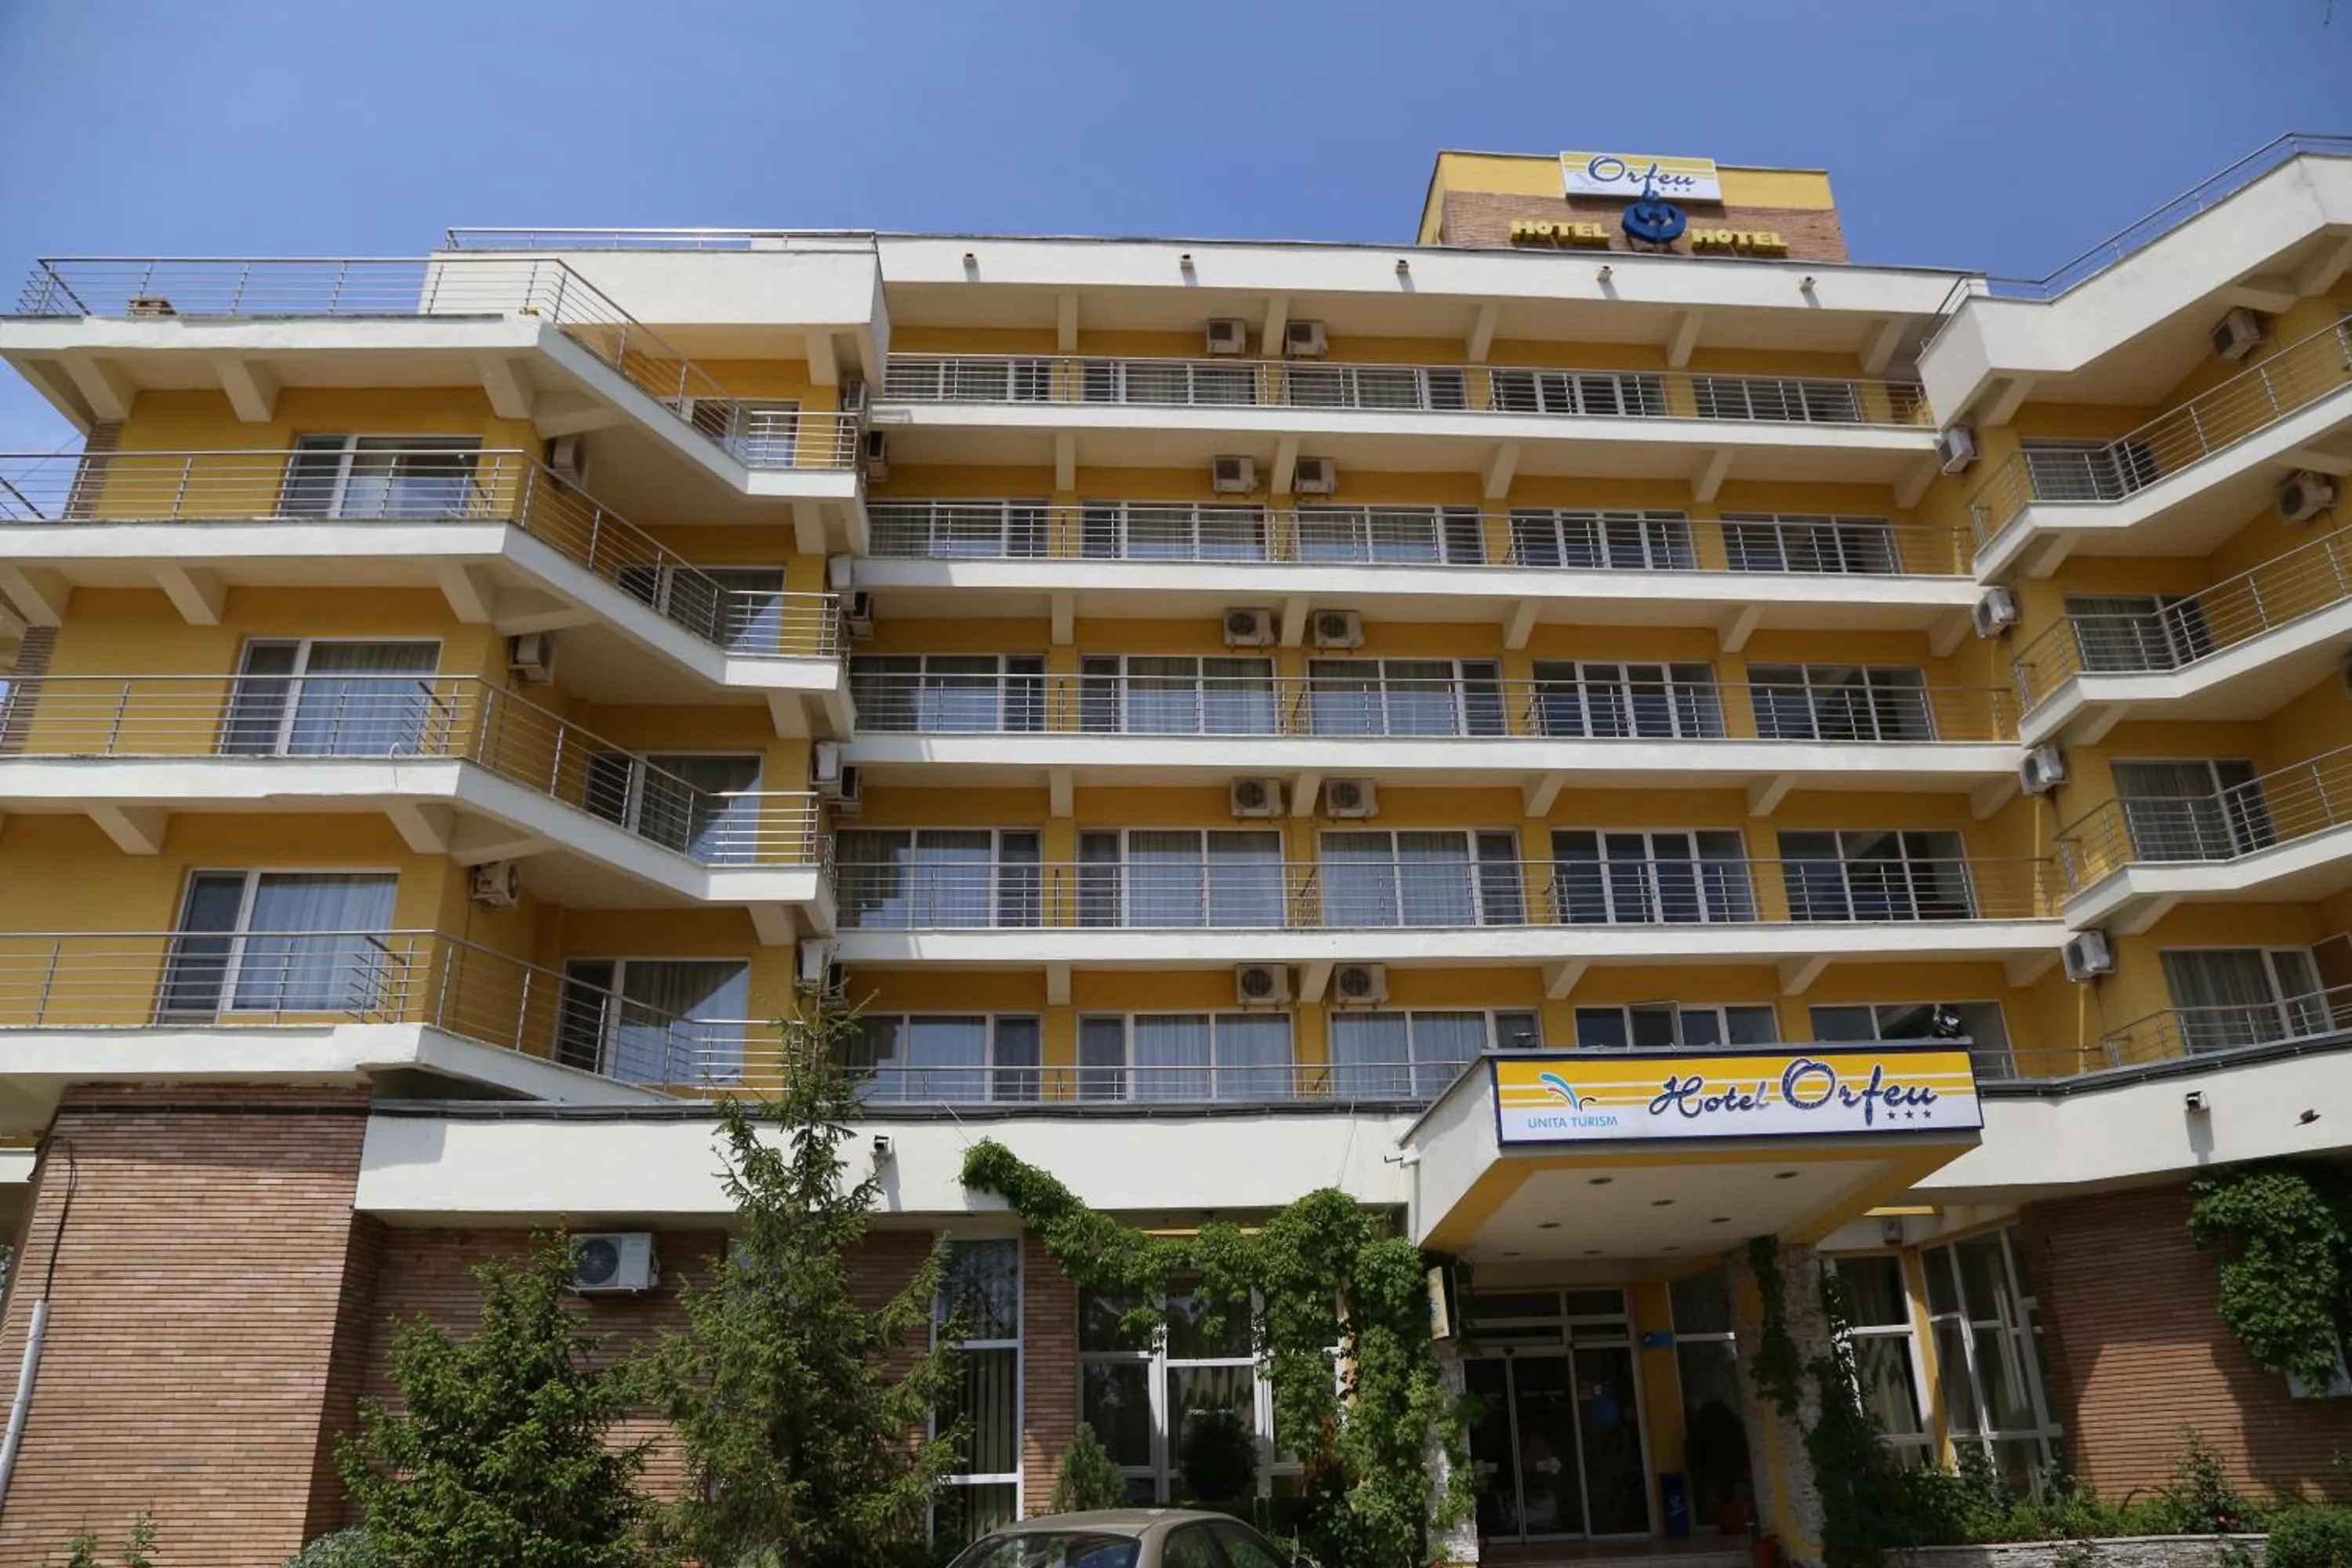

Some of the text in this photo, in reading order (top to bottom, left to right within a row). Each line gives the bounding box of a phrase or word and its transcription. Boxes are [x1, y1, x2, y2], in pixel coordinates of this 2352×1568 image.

[1588, 155, 1695, 191] Orfeu
[1510, 220, 1611, 241] HOTEL
[1690, 229, 1789, 249] HOTEL
[1648, 1057, 1939, 1127] Hotel Orfeu
[1527, 1116, 1617, 1128] UNITA TURISM
